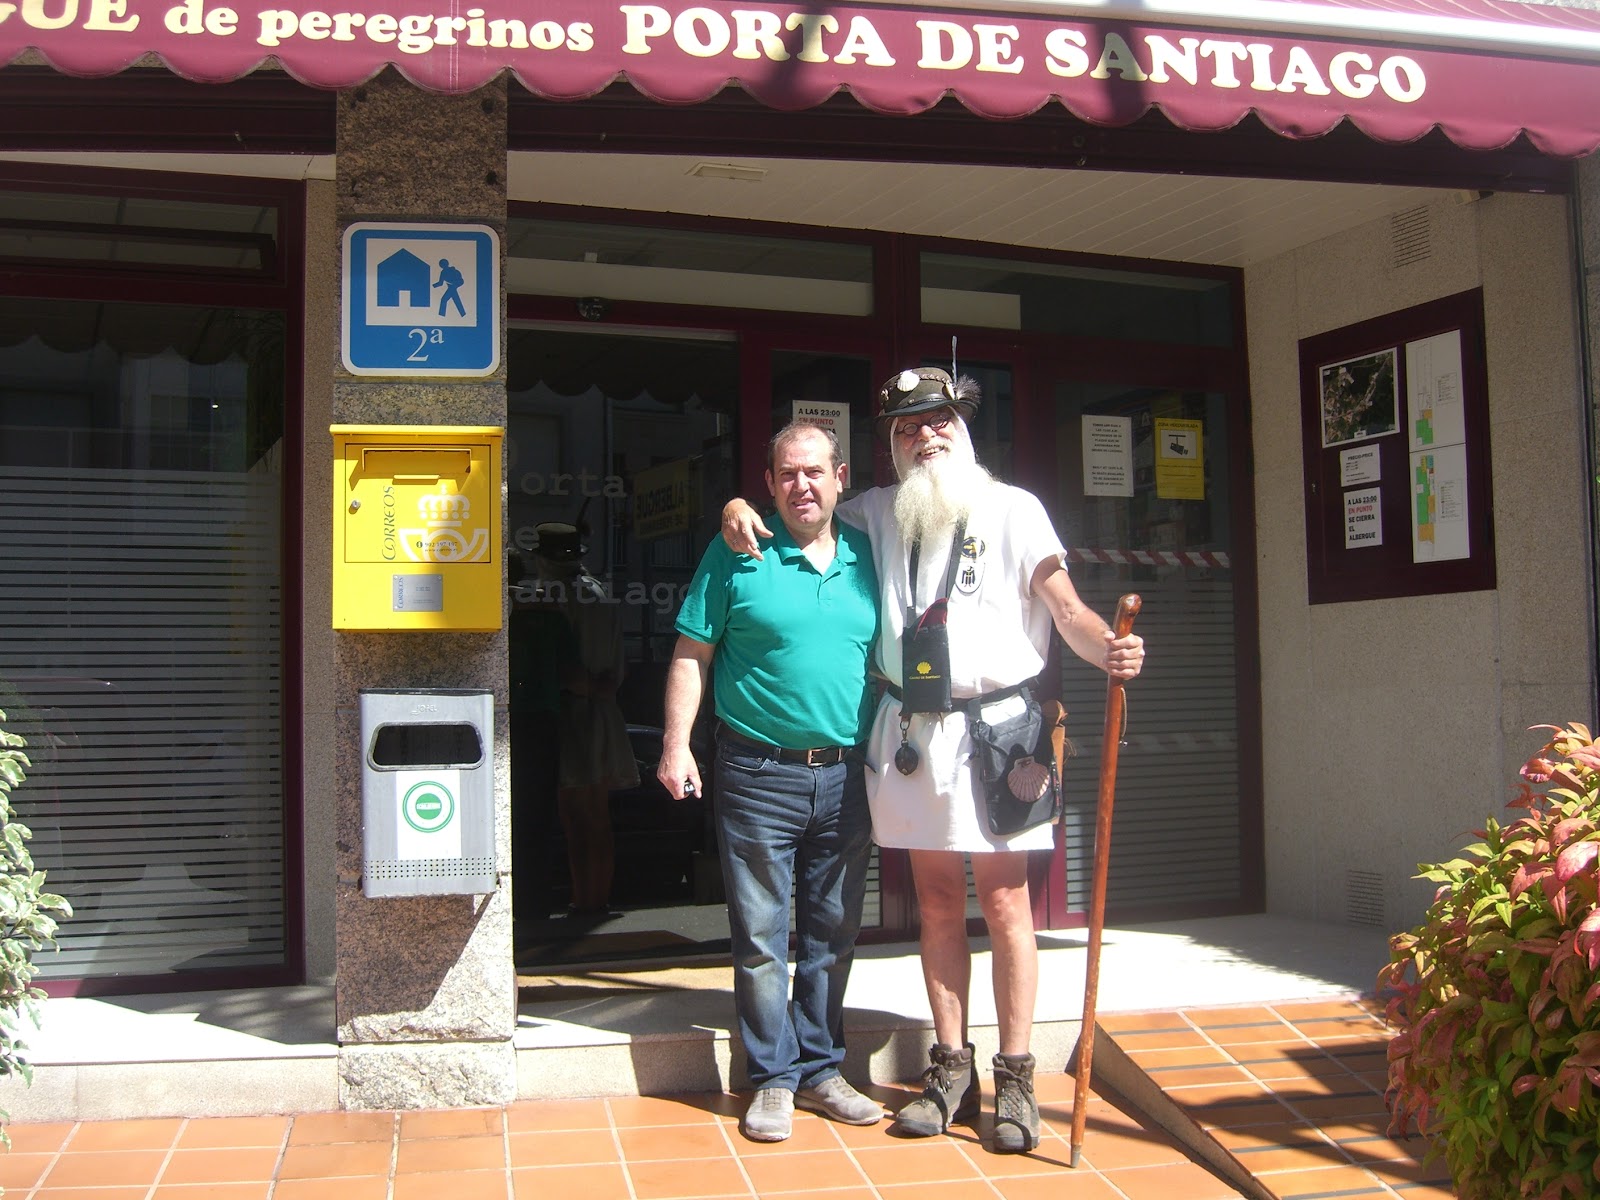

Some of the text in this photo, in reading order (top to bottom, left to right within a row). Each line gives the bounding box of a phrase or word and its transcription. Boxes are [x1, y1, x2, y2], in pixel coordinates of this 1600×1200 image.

[0, 0, 1427, 103] UE de peregrinos PORTA DE SANTIAGO
[805, 408, 819, 416] LAS
[820, 409, 841, 417] 23:00
[516, 462, 627, 498] orta
[1363, 495, 1377, 504] 23:00
[1356, 505, 1373, 513] PUNTO
[381, 485, 396, 562] CORREOS
[1356, 514, 1375, 523] CIERRA
[514, 525, 540, 551] e
[1349, 532, 1376, 541] ALBERGUE
[510, 573, 691, 616] antiag
